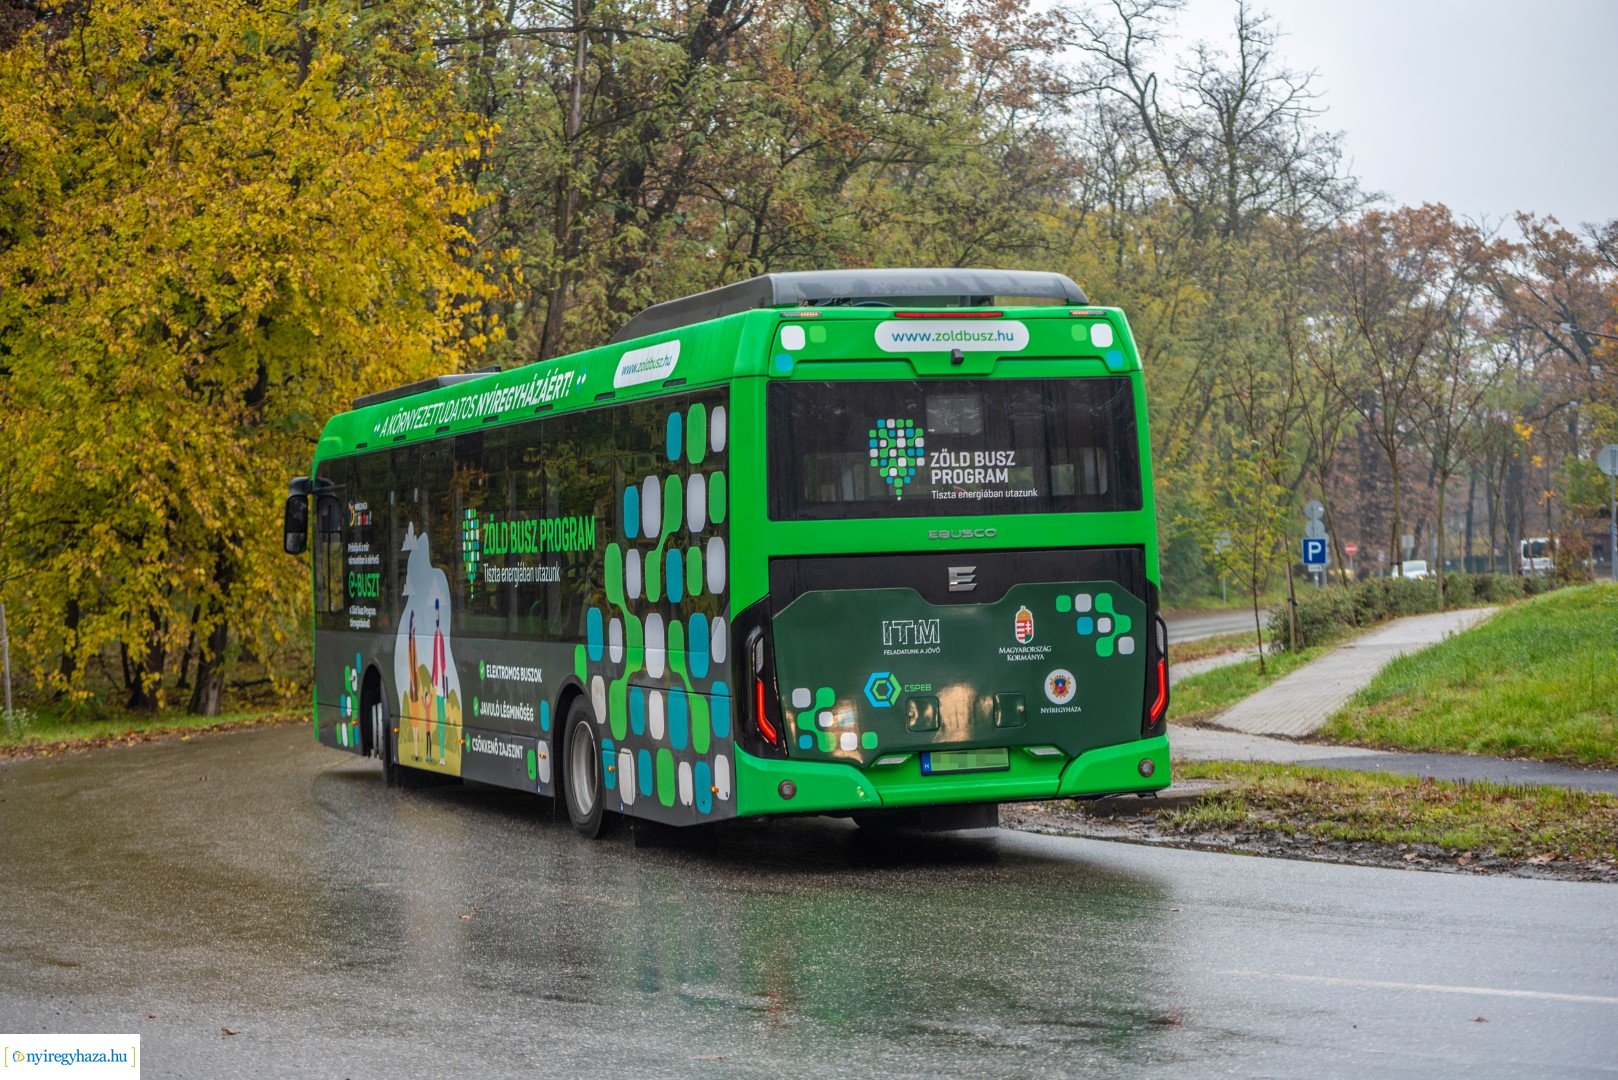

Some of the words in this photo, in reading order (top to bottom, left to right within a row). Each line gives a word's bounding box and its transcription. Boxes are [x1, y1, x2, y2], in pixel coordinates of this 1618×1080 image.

[891, 329, 1014, 343] www.zoldbusz.hu
[621, 354, 672, 376] www.zoldbusz.hu
[386, 394, 478, 436] KÖRNYEZETTUDATOS
[474, 367, 575, 418] NYÍREGYHÁZÁÉRT!
[930, 448, 970, 468] ZÖLD
[974, 451, 1016, 466] BUSZ
[931, 468, 1008, 484] PROGRAM
[932, 490, 956, 500] Tiszta
[958, 489, 1004, 500] energiában
[1005, 488, 1038, 498] utazunk
[510, 519, 538, 554] BUSZ
[540, 515, 596, 552] PROGRAM
[928, 528, 997, 540] EBUSCO
[1308, 542, 1322, 562] P
[348, 570, 380, 598] e-BUSZT
[483, 563, 500, 582] Tiszta
[502, 562, 534, 588] energiában
[535, 561, 561, 582] utazunk
[882, 618, 940, 646] ITM
[998, 645, 1052, 654] MAGYARORSZÁG
[486, 664, 520, 680] ELEKTROMOS
[520, 666, 542, 683] BUSZOK
[904, 684, 932, 692] CSPEB
[480, 700, 500, 717] JAVULÓ
[500, 702, 534, 722] LÉGMINŐSÉG
[471, 735, 498, 754] CSÖKKENŐ
[498, 744, 523, 760] ZAJSZINT
